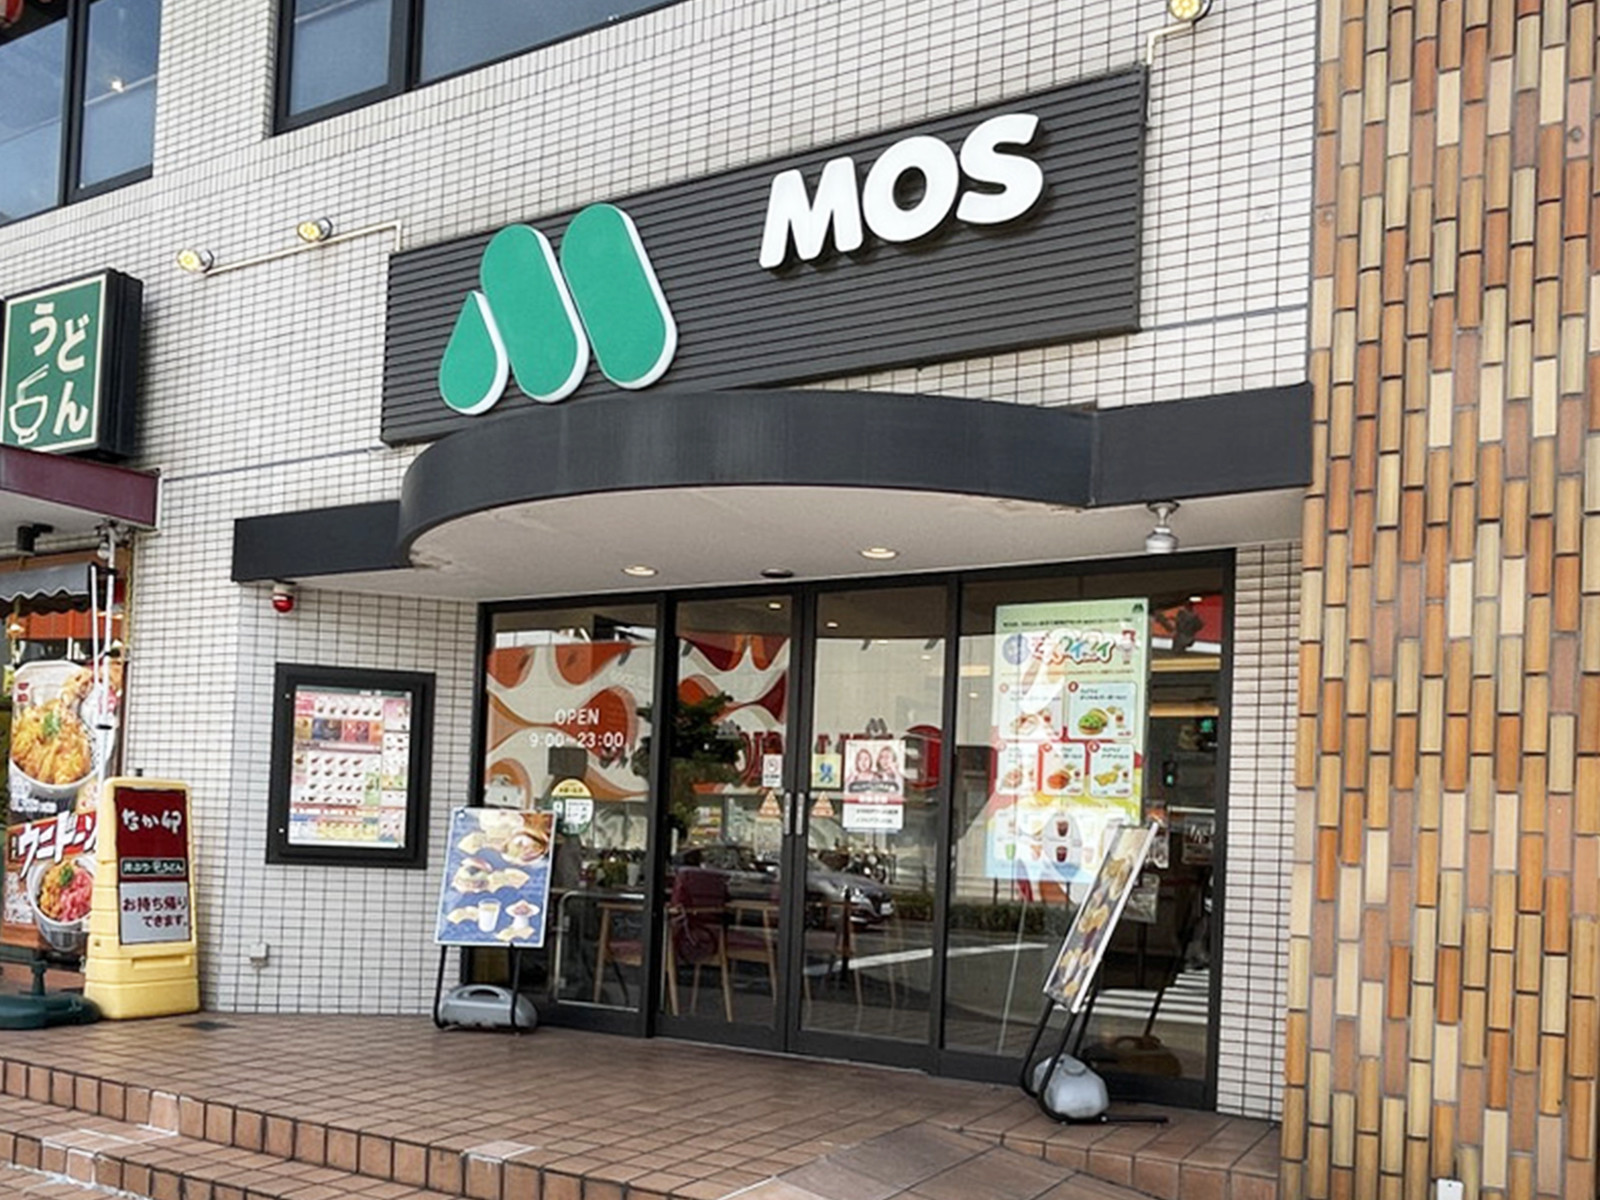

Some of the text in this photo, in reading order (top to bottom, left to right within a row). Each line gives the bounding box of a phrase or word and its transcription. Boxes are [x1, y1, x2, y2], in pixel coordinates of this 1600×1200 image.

[759, 113, 1043, 268] MOS
[30, 302, 90, 436] うどん
[555, 708, 600, 725] OPEN
[121, 808, 182, 834] なか卯
[122, 896, 188, 912] お持ち帰り
